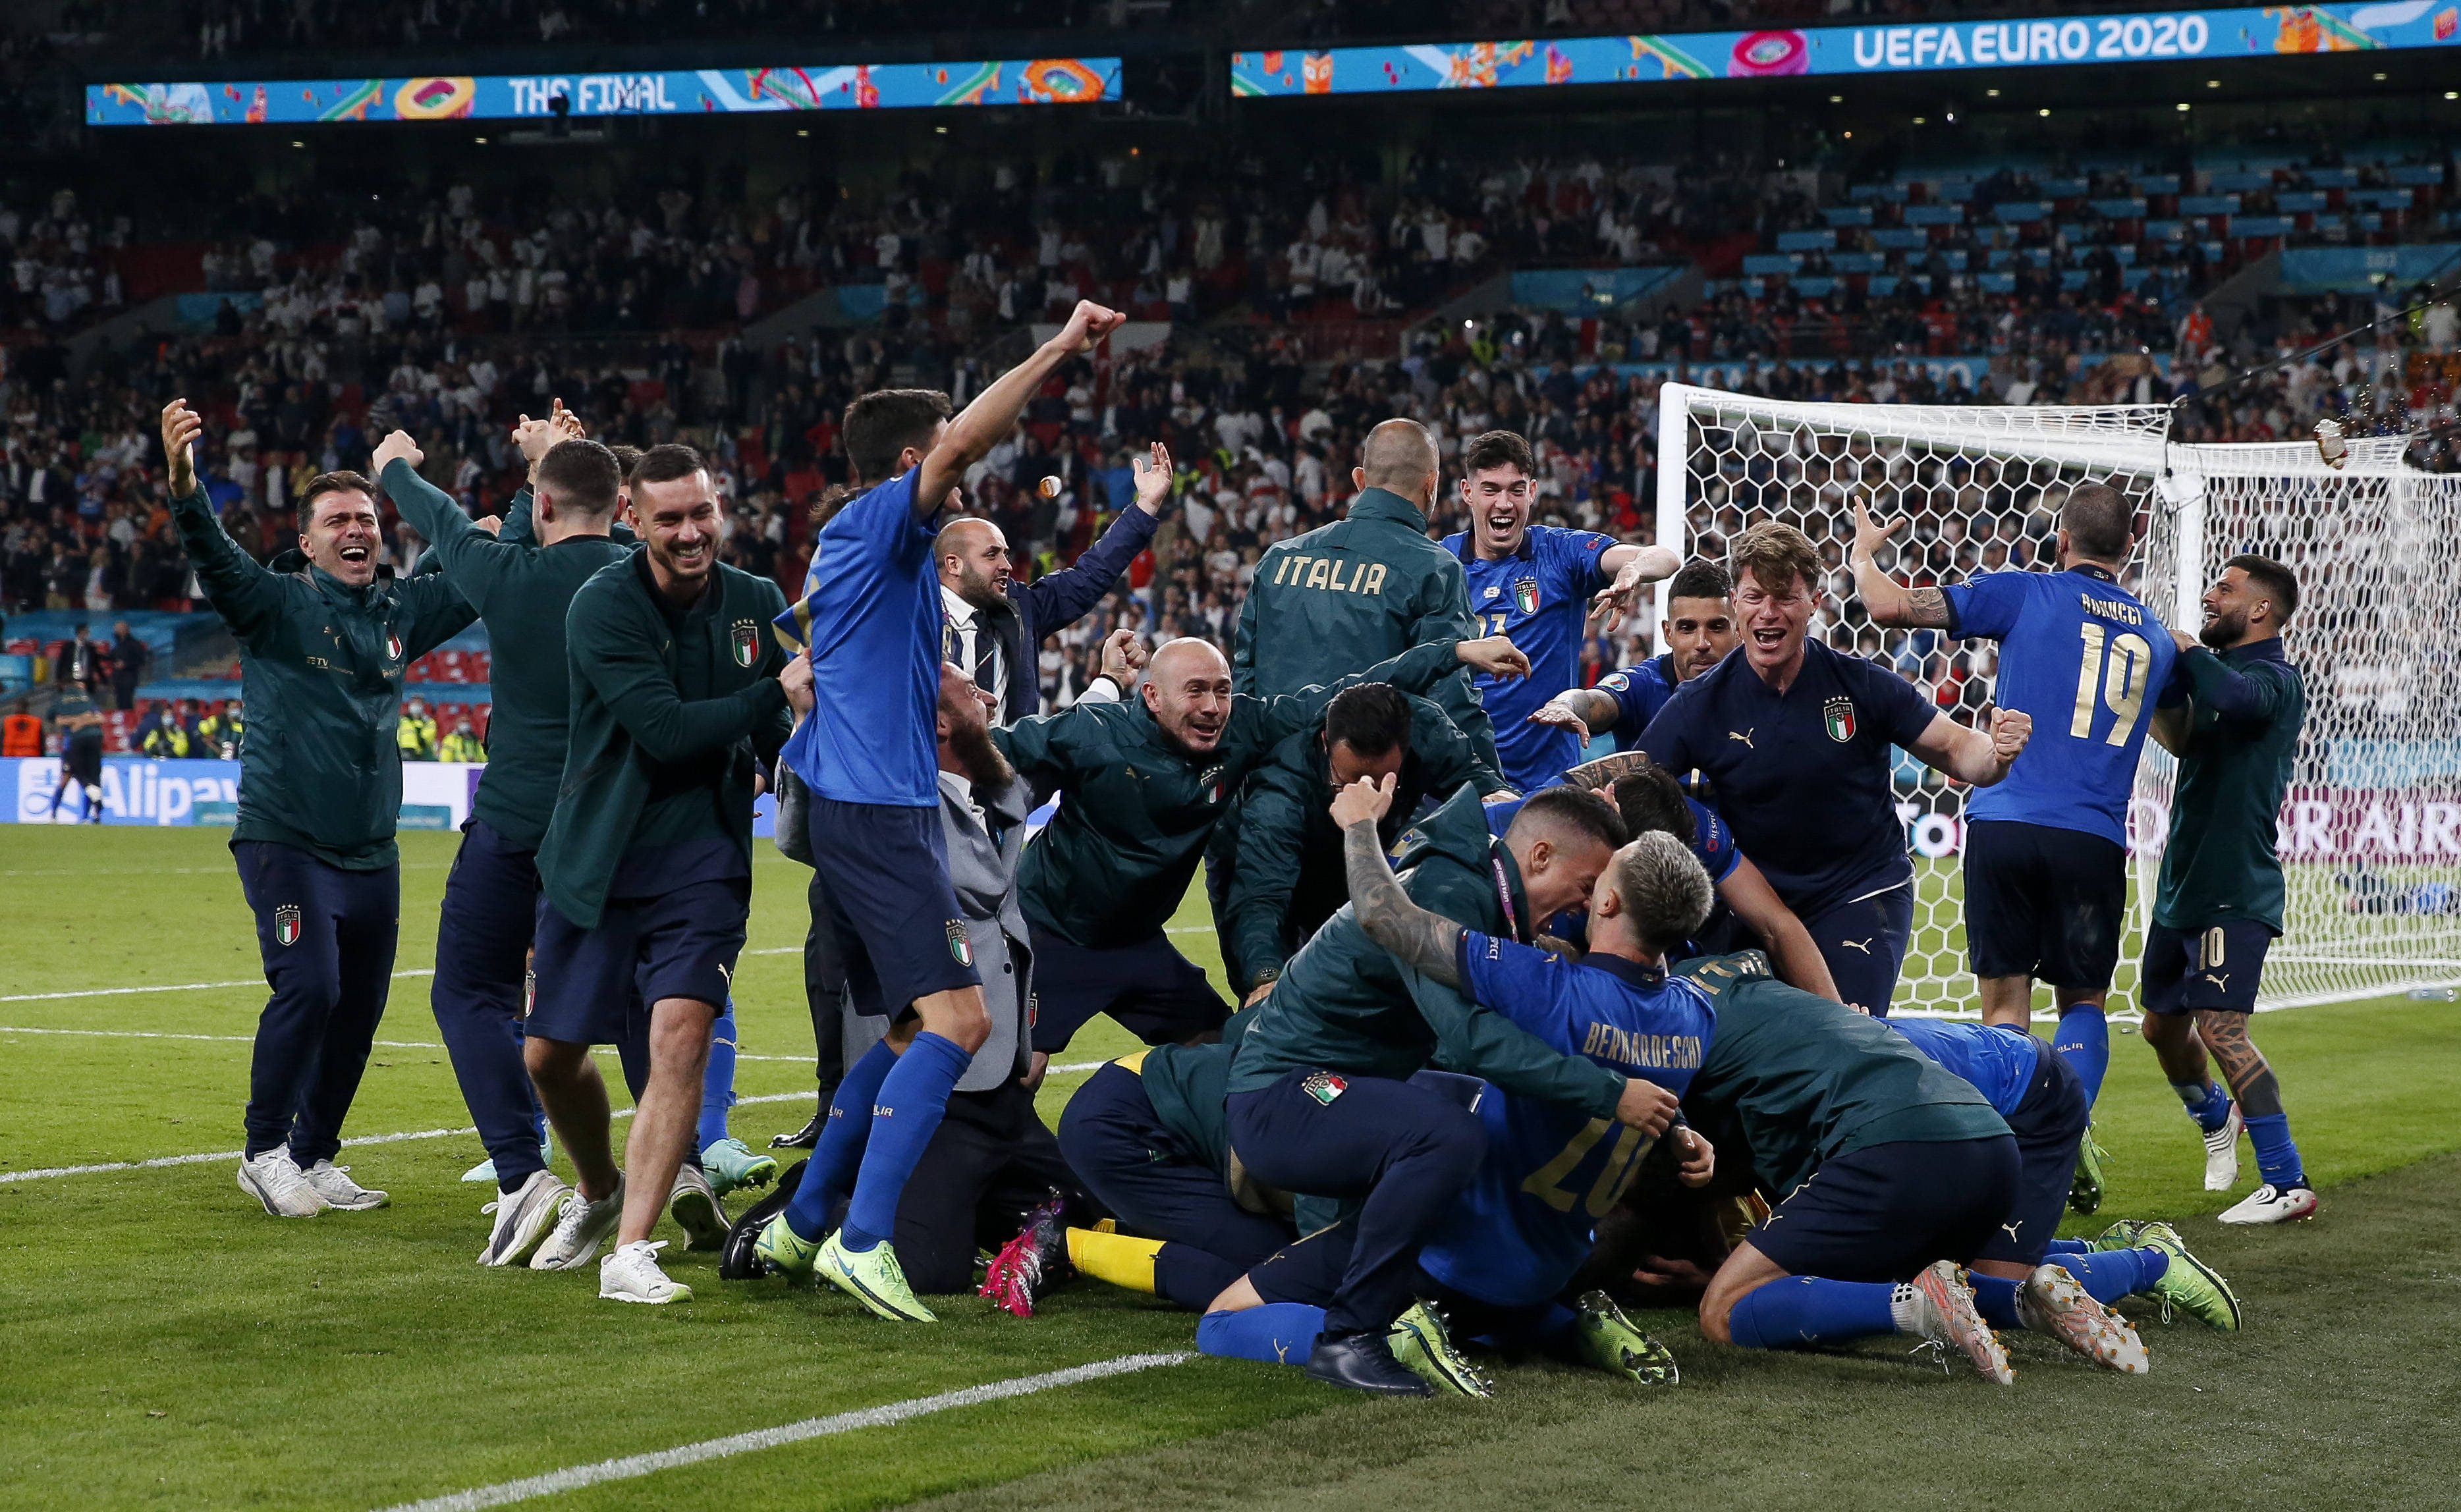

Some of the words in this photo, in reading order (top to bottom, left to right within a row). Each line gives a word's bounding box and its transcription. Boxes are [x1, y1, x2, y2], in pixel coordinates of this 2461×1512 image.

[1854, 27, 1966, 67] UEFA
[1972, 21, 2090, 63] EURO
[2096, 15, 2209, 58] 2020
[578, 75, 677, 113] FINAL
[1273, 556, 1388, 595] ITALIA
[1516, 583, 1536, 591] ITALIA
[2081, 592, 2143, 626] BONUCCI
[2069, 621, 2152, 748] 19
[1827, 705, 1850, 715] ITALIA
[101, 763, 240, 826] Alipa
[2198, 926, 2225, 971] 10
[1582, 1021, 1703, 1069] BERNARDESCHI
